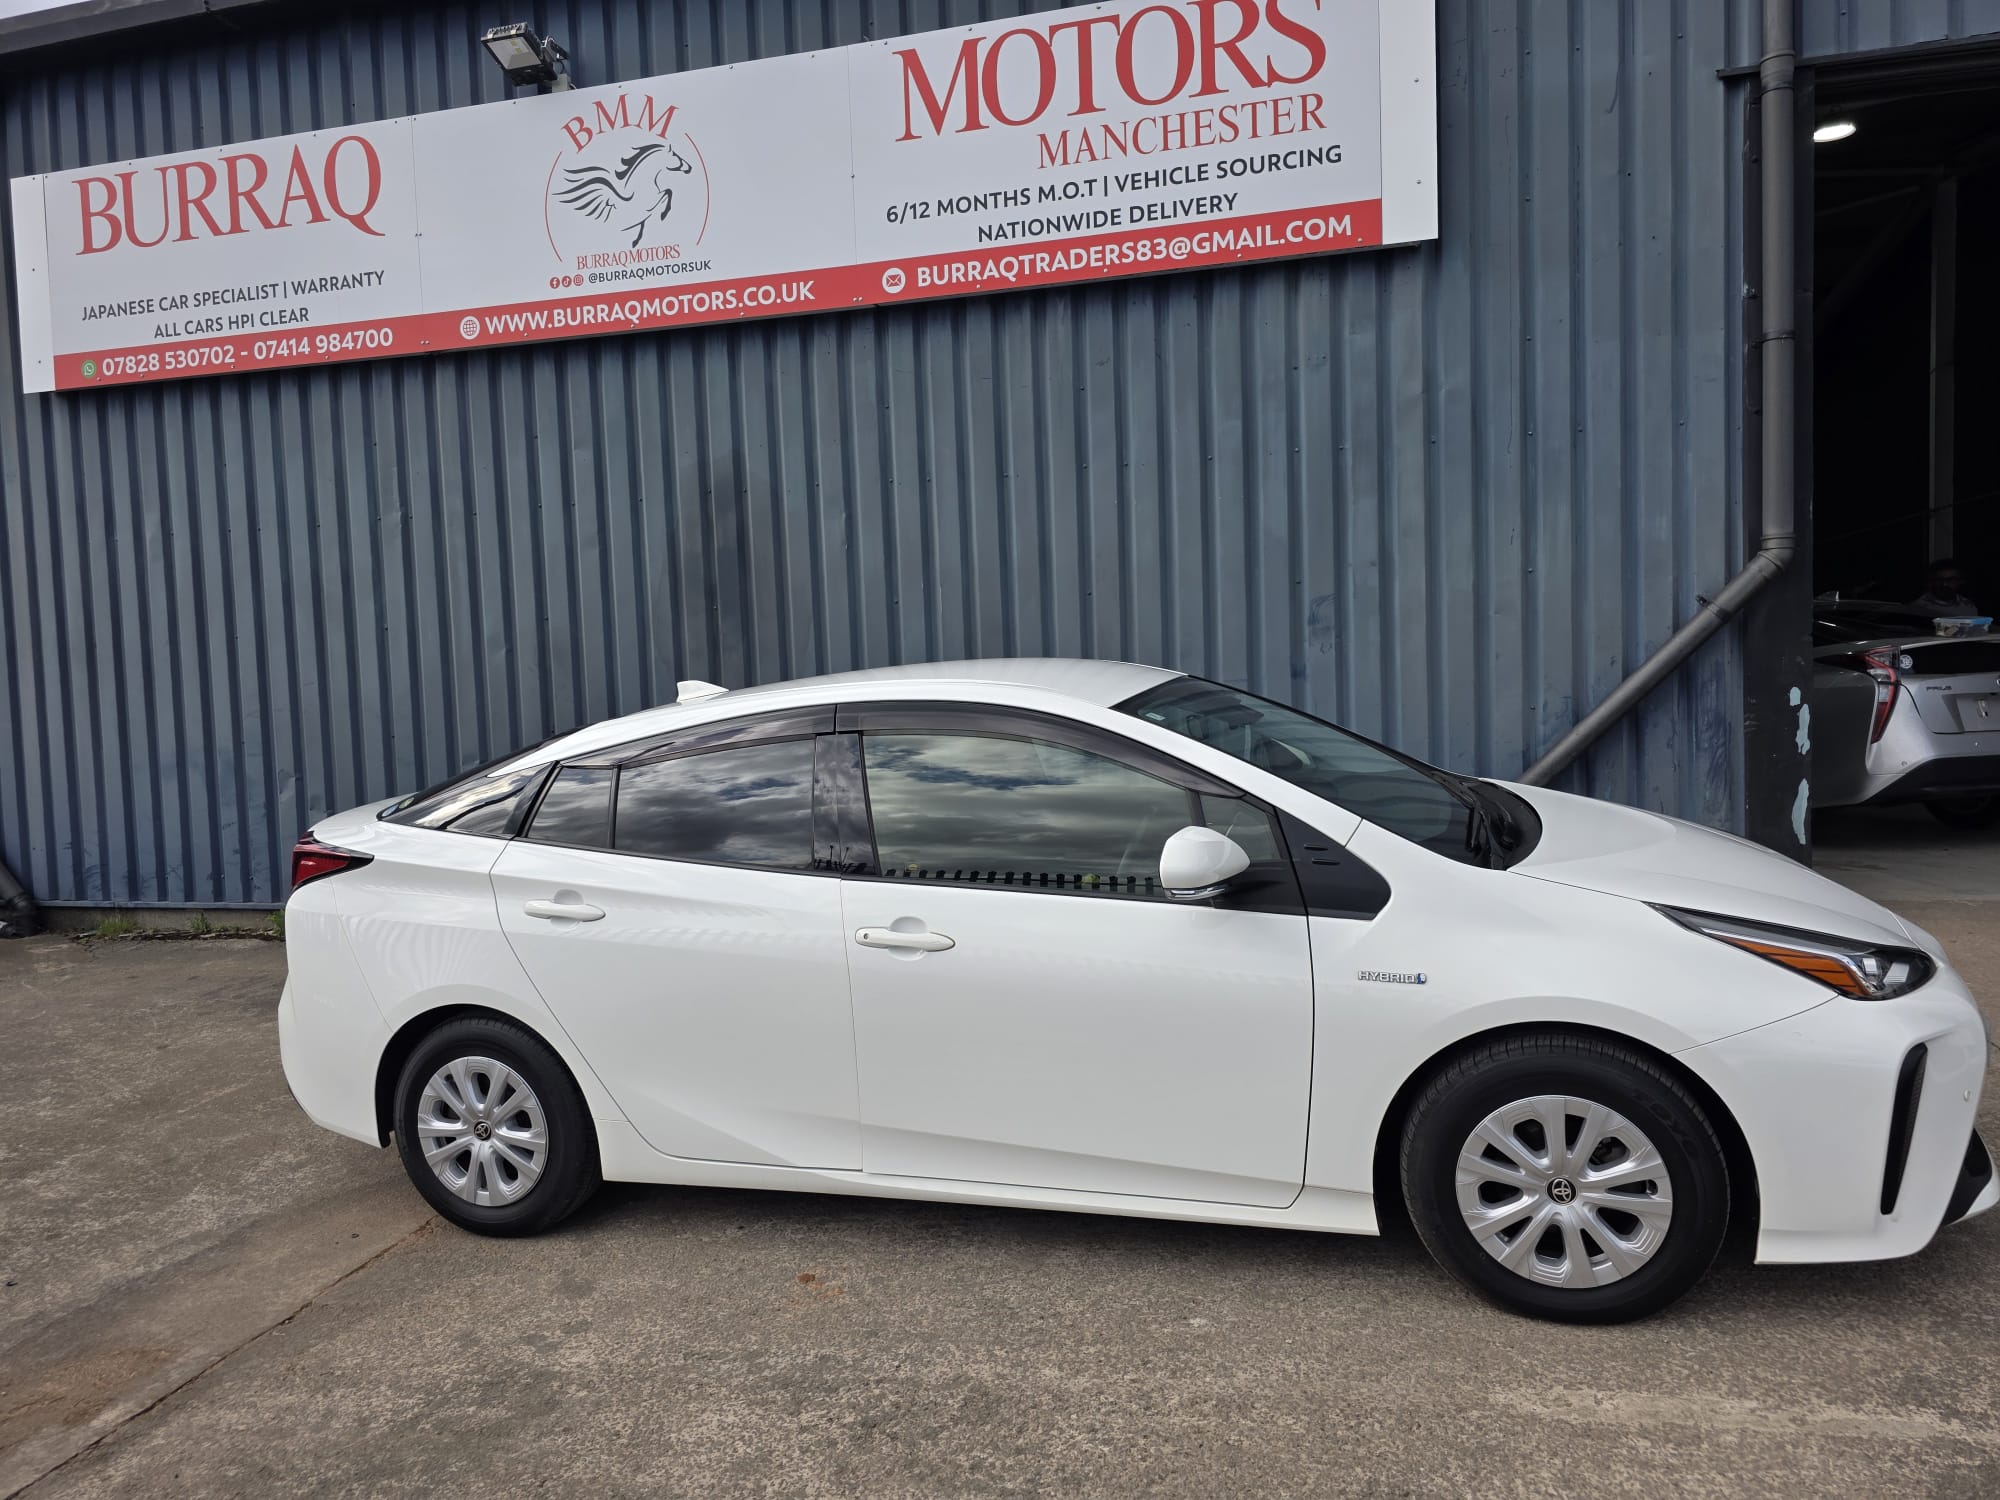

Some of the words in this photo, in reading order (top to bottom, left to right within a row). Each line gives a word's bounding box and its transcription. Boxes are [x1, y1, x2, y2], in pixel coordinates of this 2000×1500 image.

[891, 0, 1327, 142] MOTORS
[561, 93, 680, 153] BMM
[1036, 93, 1328, 169] MANCHESTER
[72, 135, 386, 256] BURRAQ
[886, 200, 931, 225] 6/12
[937, 188, 1031, 217] MONTHS
[1038, 178, 1098, 204] M.O.T
[1114, 163, 1210, 193] VEHICLE
[1216, 144, 1342, 180] SOURCING
[978, 208, 1122, 243] NATIONWIDE
[1129, 192, 1239, 224] DELIVERY
[588, 259, 712, 284] @BURRAQMOTORSUK
[917, 214, 1352, 288] BURRAQTRADERS83@GMAIL.COM
[81, 299, 155, 321] JAPANESE
[158, 294, 189, 312] CAR
[193, 283, 280, 308] SPECIALIST
[290, 270, 385, 296] WARRANTY
[485, 281, 816, 332] WWW.BURRAQMOTORS.CO.UK
[154, 322, 182, 339] ALL
[184, 317, 224, 335] CARS
[228, 313, 255, 331] HPI
[259, 307, 310, 327] CLEAR
[102, 353, 160, 376] 07828
[165, 345, 236, 370] 530702
[253, 336, 311, 360] 07414
[315, 327, 394, 354] 984700
[1358, 970, 1417, 984] HYBRID
